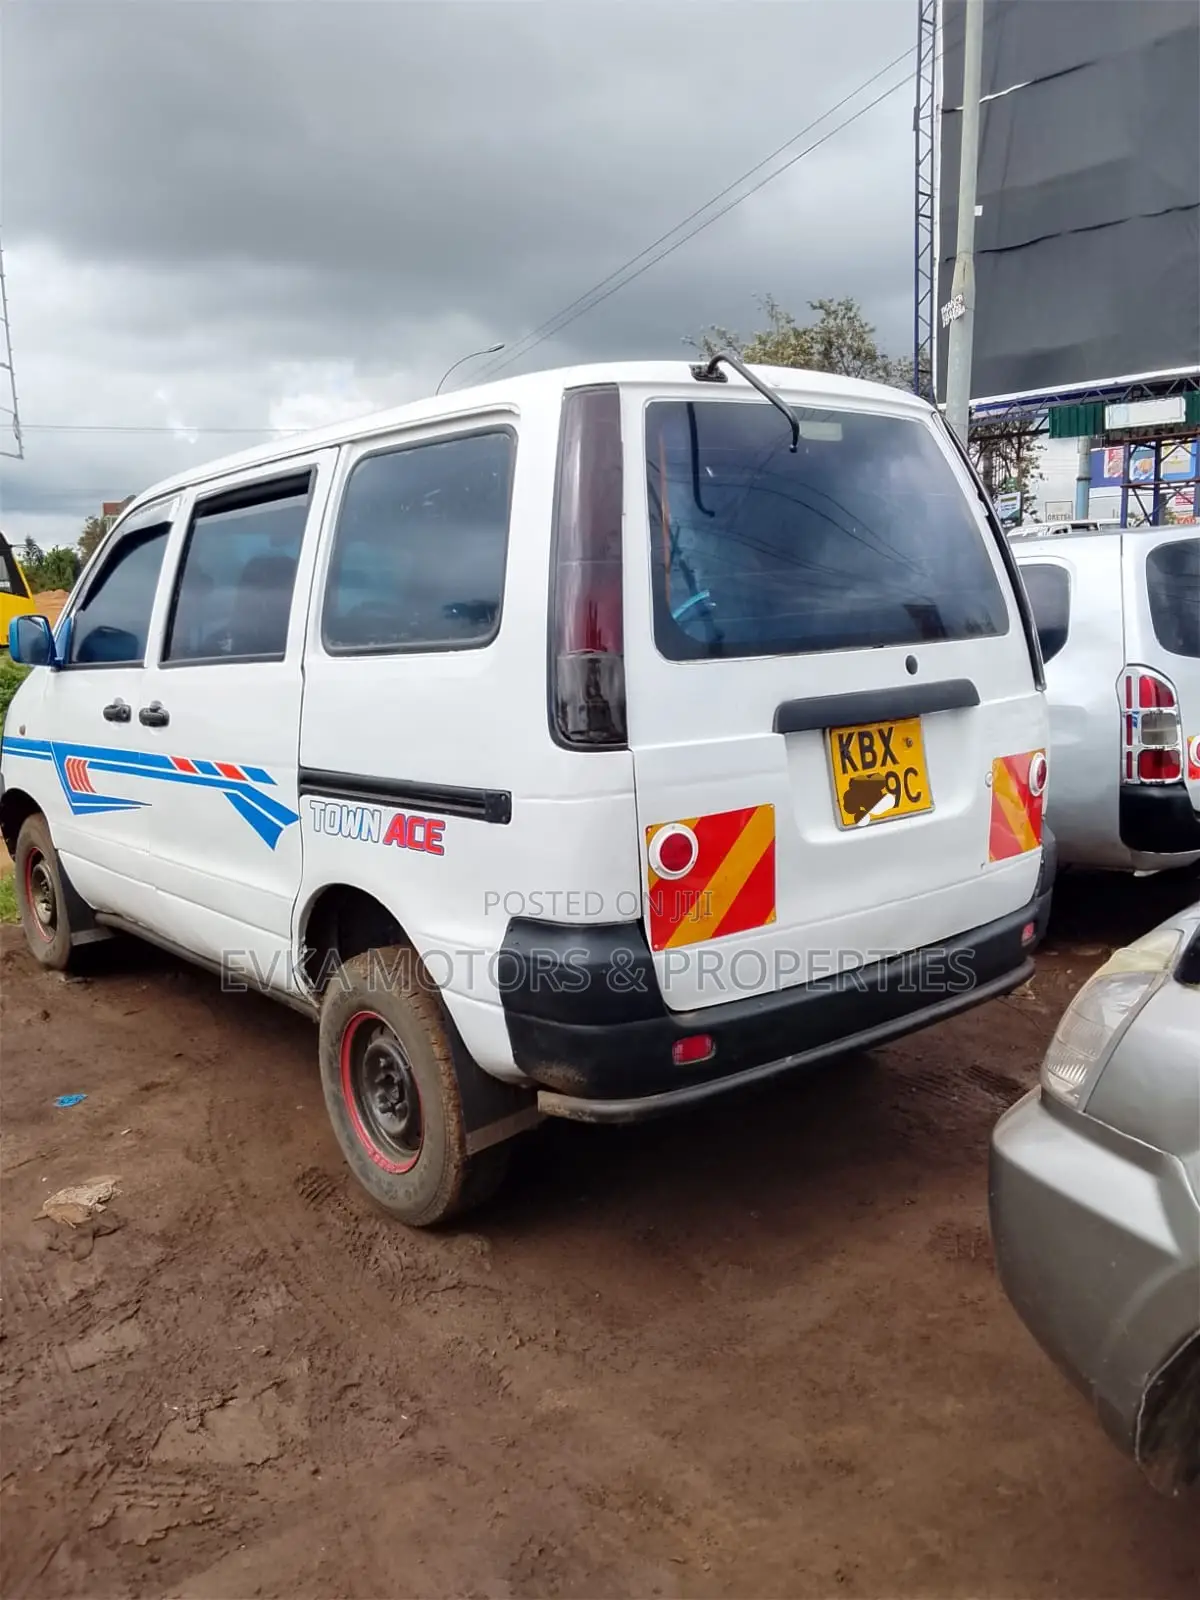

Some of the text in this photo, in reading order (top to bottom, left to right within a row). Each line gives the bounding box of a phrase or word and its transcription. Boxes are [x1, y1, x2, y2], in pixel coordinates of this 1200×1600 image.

[837, 726, 900, 774] KBX
[309, 800, 446, 856] TOWN ACE
